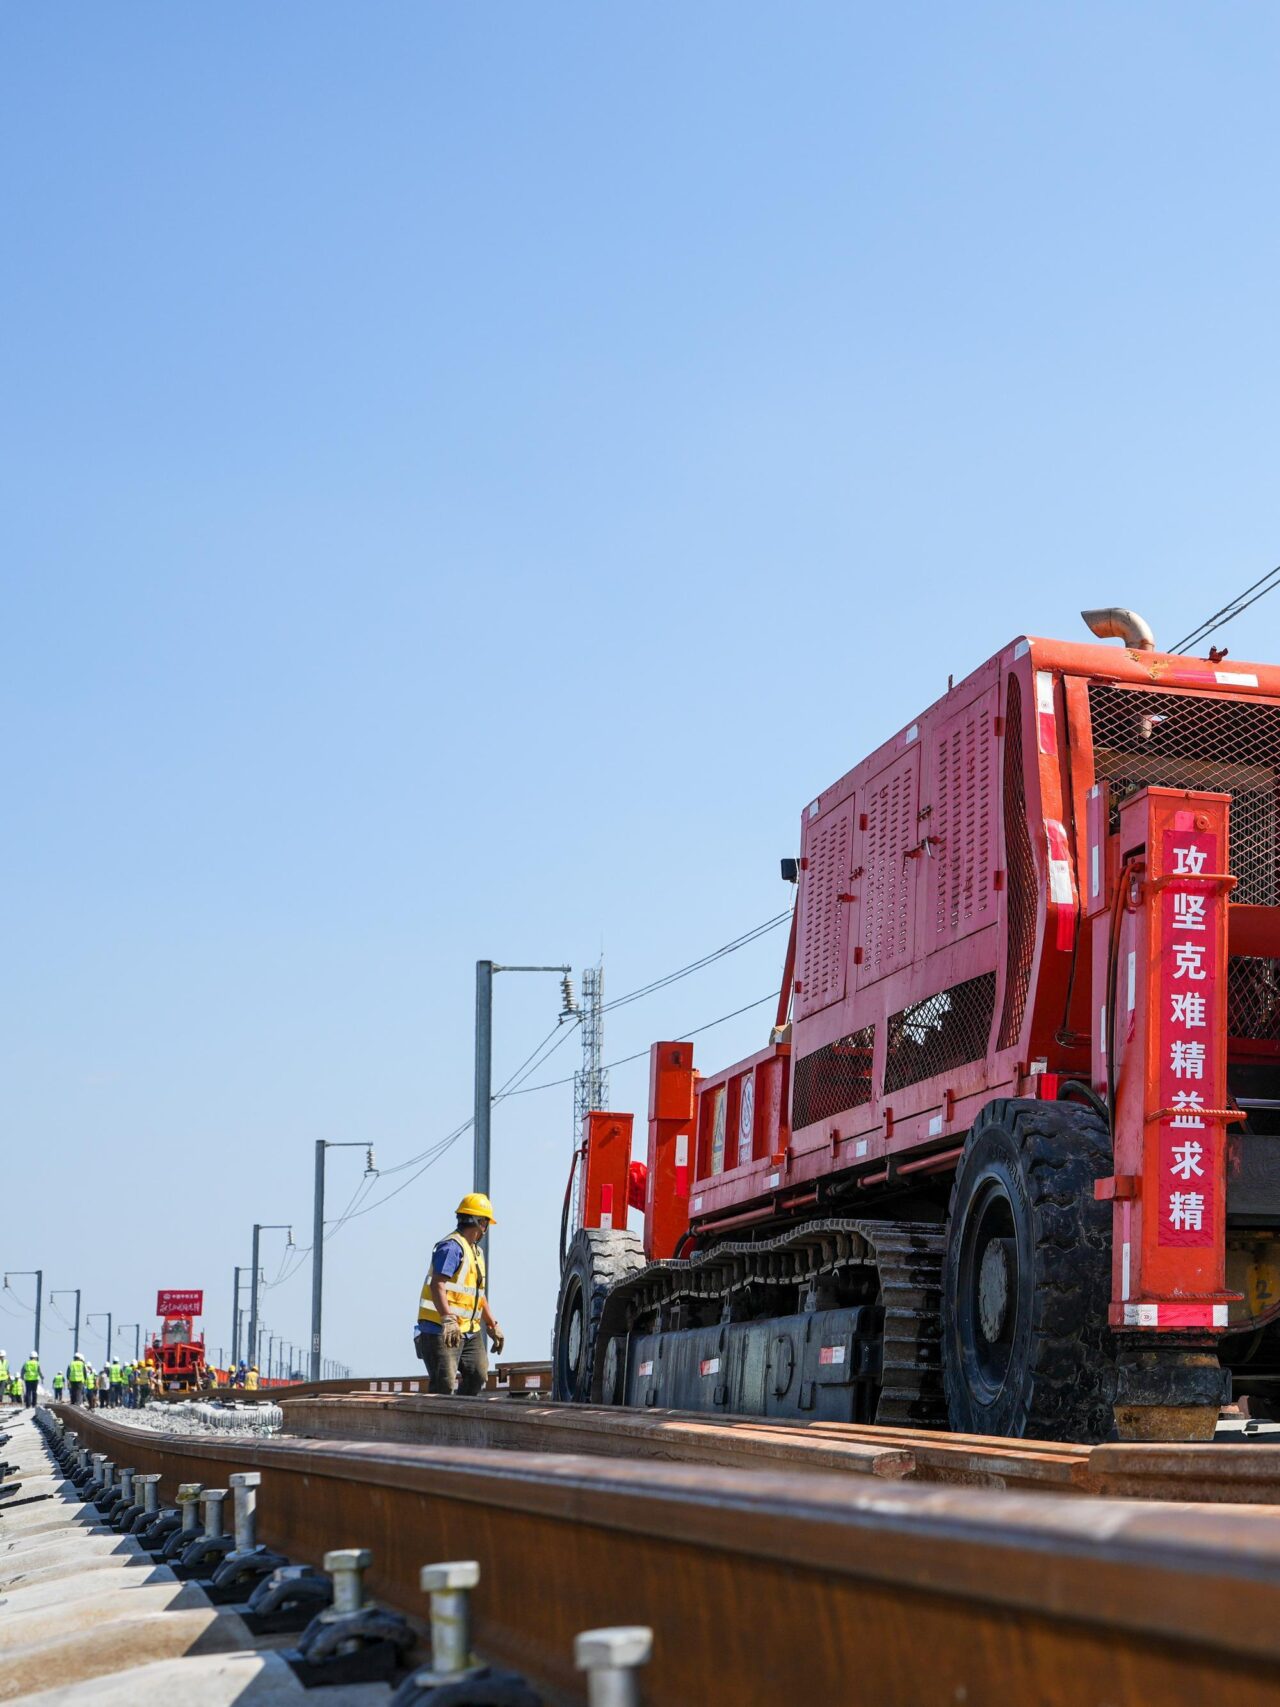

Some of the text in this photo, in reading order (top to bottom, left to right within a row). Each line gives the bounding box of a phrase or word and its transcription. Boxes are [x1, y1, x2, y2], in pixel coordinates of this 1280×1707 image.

[1168, 844, 1207, 1231] 攻坚克难精益求精
